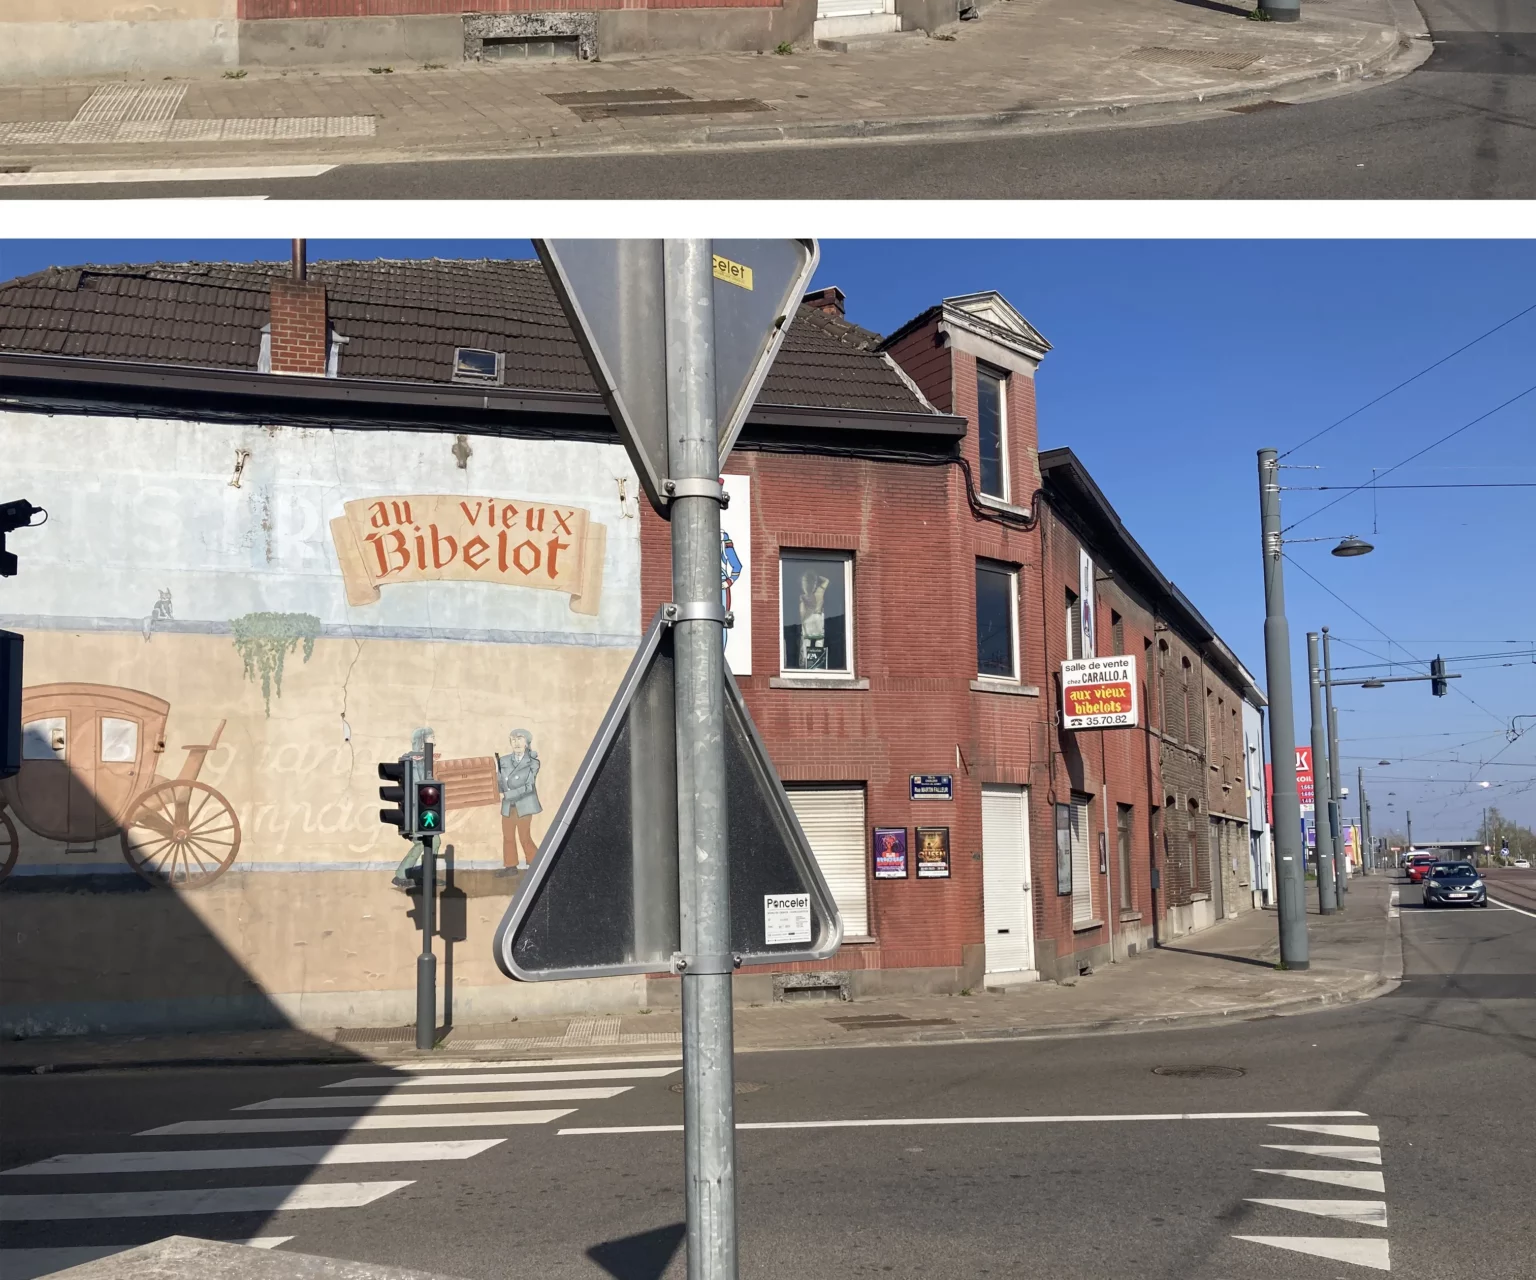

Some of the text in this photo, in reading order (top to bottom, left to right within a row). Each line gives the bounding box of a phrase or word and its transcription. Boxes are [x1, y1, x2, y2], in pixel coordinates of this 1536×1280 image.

[368, 500, 414, 528] au
[459, 498, 575, 535] vieux
[364, 523, 571, 580] Bibelot
[1065, 660, 1129, 672] salle de vente
[1070, 686, 1126, 701] aux vieux
[1074, 701, 1122, 714] bibelots
[1086, 715, 1127, 726] 35.70.82
[767, 897, 808, 908] Poncelet
